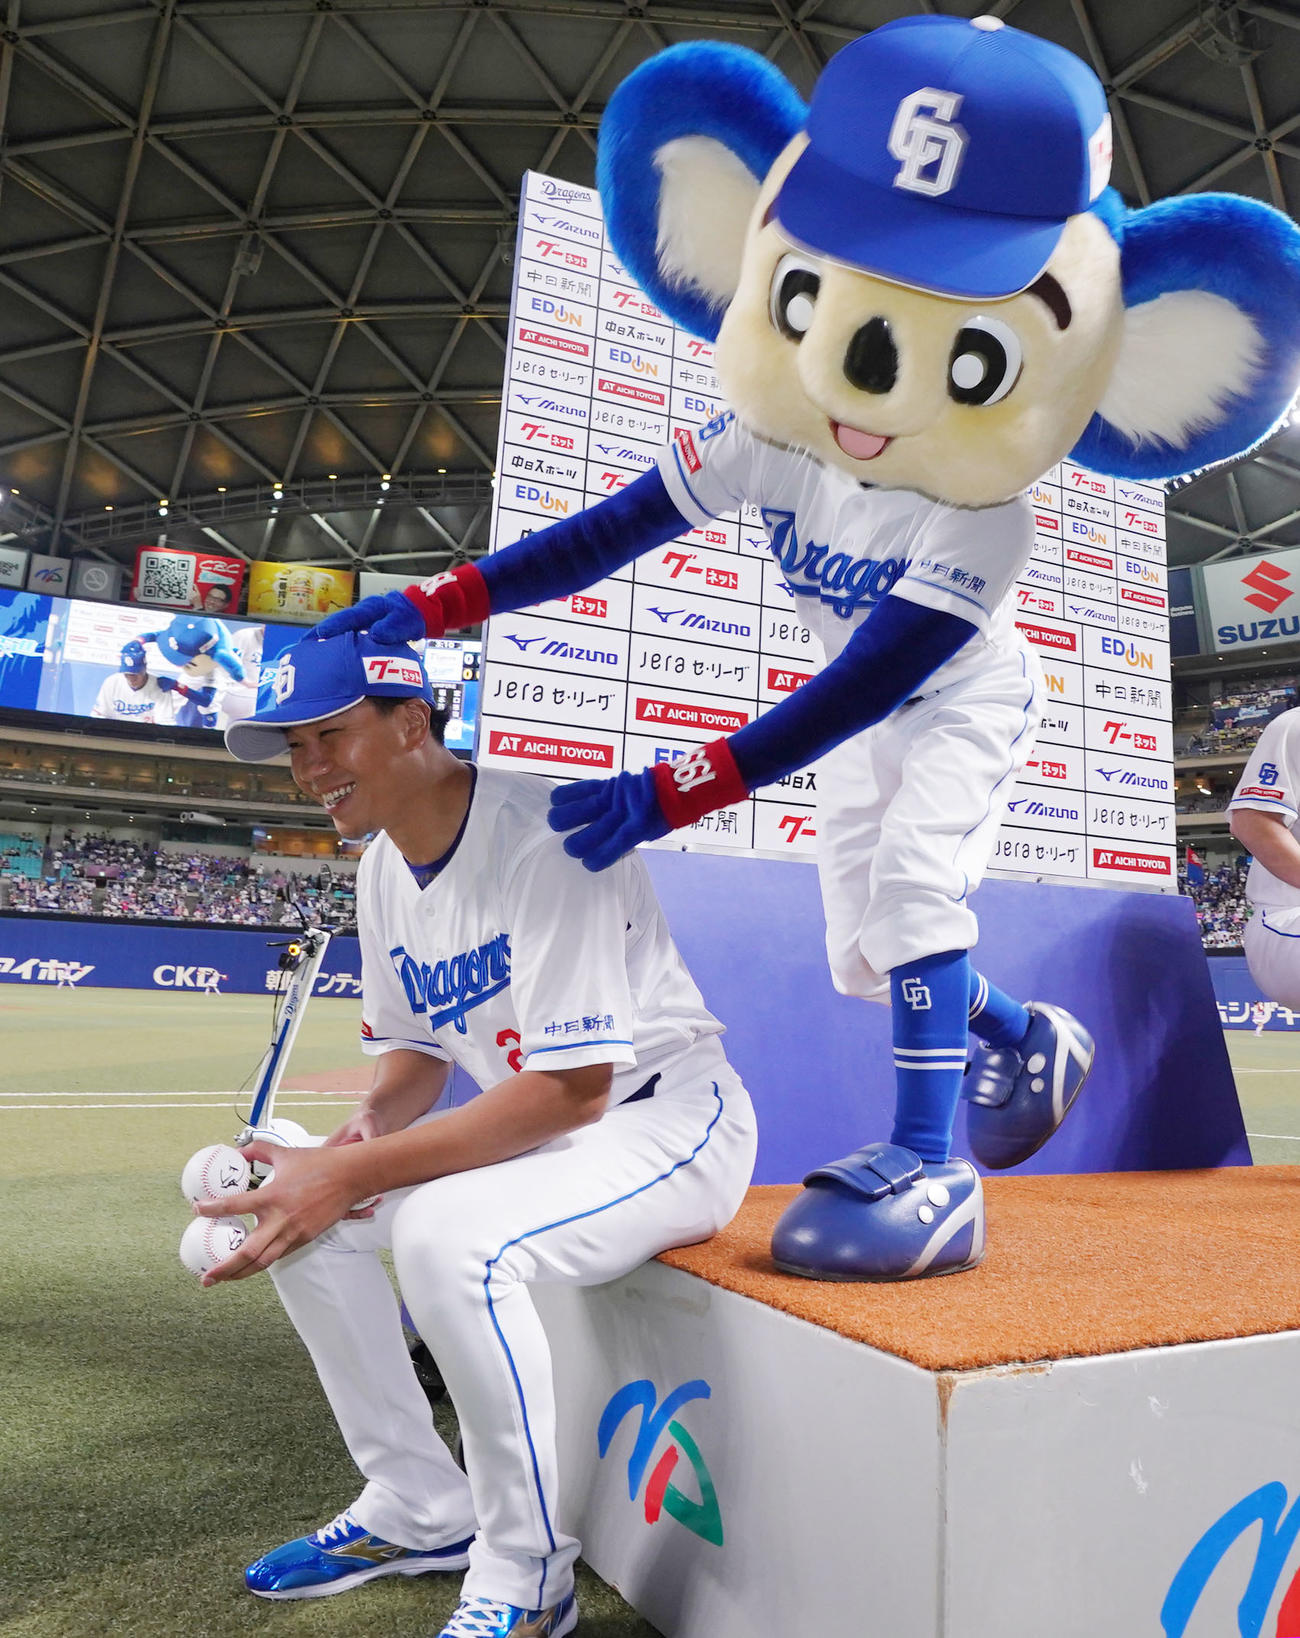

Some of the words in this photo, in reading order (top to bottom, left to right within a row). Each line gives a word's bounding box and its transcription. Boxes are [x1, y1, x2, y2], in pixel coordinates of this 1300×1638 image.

[542, 181, 592, 204] Dragons
[528, 270, 592, 297] 中日新聞
[531, 298, 582, 327] EDION
[605, 320, 665, 345] 中日スポーツ
[609, 348, 658, 376] EDION
[512, 455, 577, 479] 中日スポーツ
[516, 484, 568, 513] EDION
[1072, 522, 1106, 545] EDION
[199, 560, 240, 573] CBC
[1126, 561, 1159, 583] EDION
[1041, 631, 1071, 646] TOYOTA
[1218, 616, 1300, 644] SUZU
[1101, 636, 1153, 670] EDION
[693, 660, 750, 682] セ・リーグ
[774, 673, 794, 688] AT
[553, 688, 615, 710] セ・リーグ
[1096, 680, 1162, 709] 中日新聞
[643, 702, 665, 718] AT
[667, 708, 698, 723] AICHI
[700, 713, 742, 728] TOYOTA
[497, 736, 521, 752] AT
[524, 741, 558, 756] AICHI
[560, 745, 606, 761] TOYOTA
[1098, 853, 1113, 865] AT
[1114, 857, 1137, 867] AICHI
[1137, 859, 1167, 870] TOYOTA
[545, 1015, 615, 1037] 中日新聞
